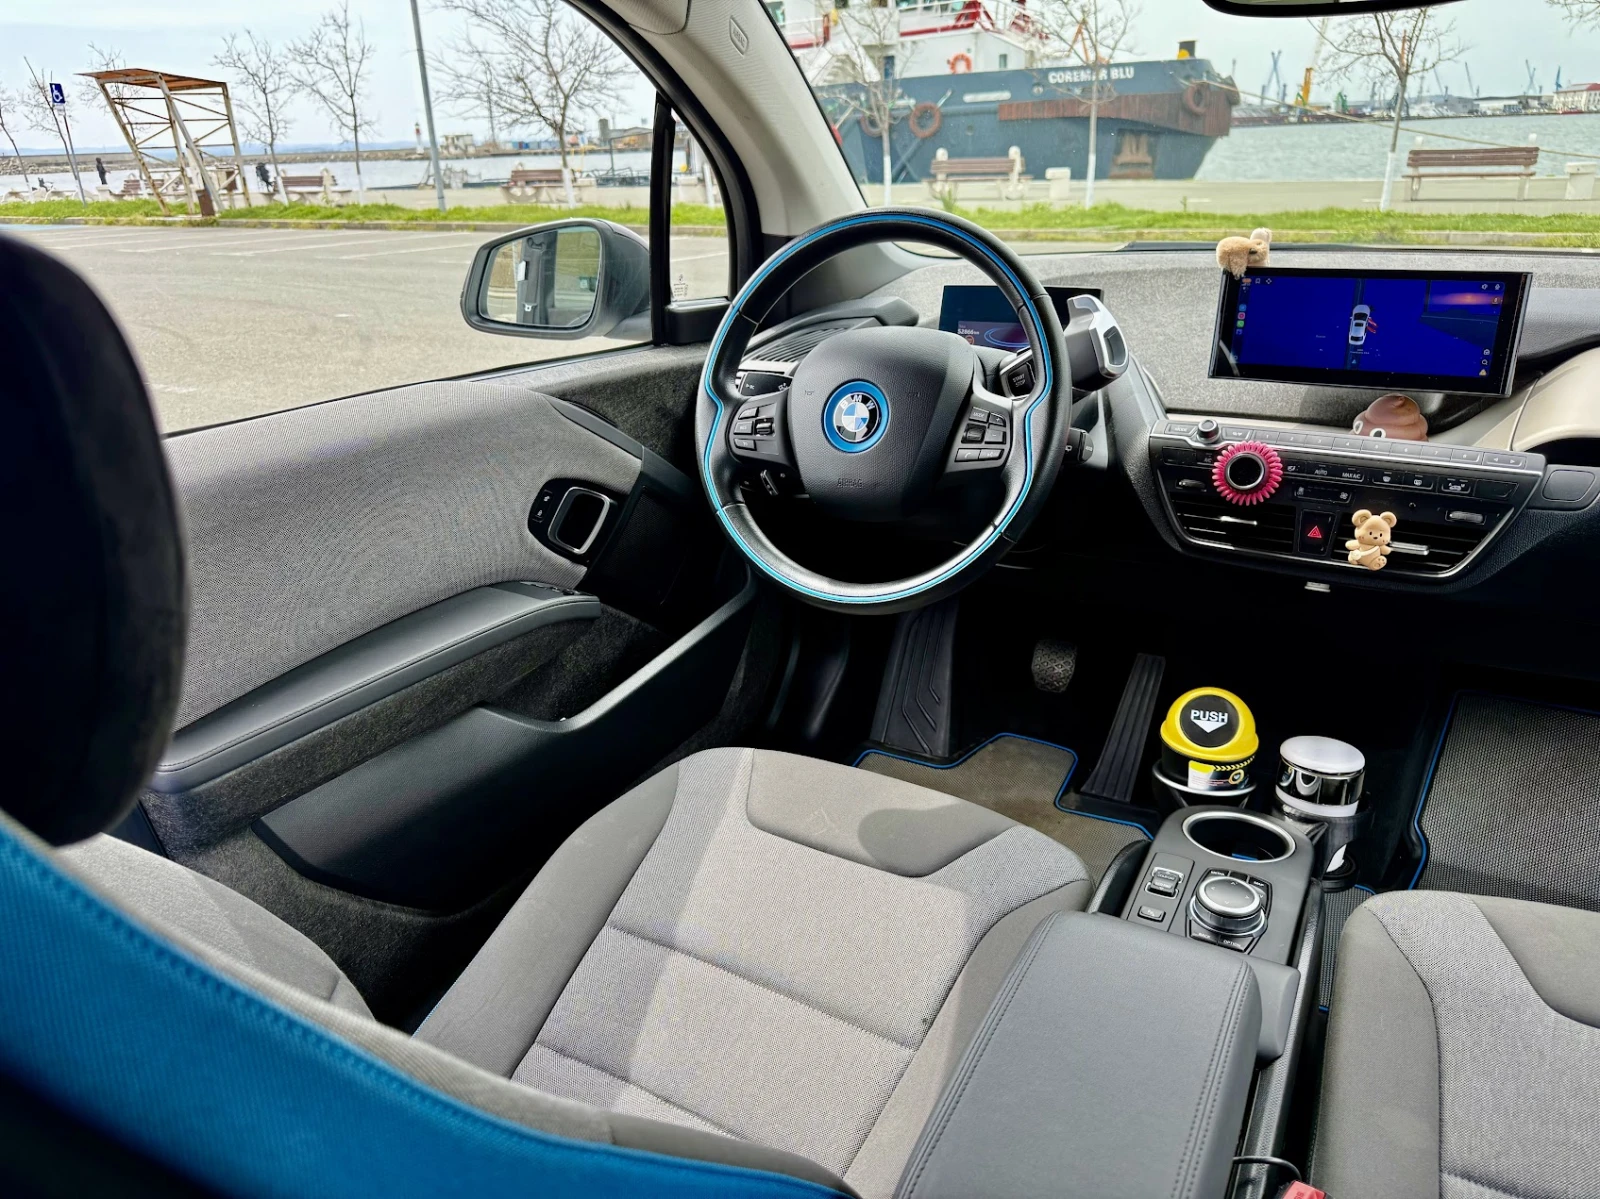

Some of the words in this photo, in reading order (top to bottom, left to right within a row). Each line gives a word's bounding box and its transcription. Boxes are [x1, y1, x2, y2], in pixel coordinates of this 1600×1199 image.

[1110, 66, 1134, 79] BLU
[840, 394, 875, 410] BMW
[1191, 709, 1228, 723] PUSH
[1223, 939, 1242, 947] OPTION
